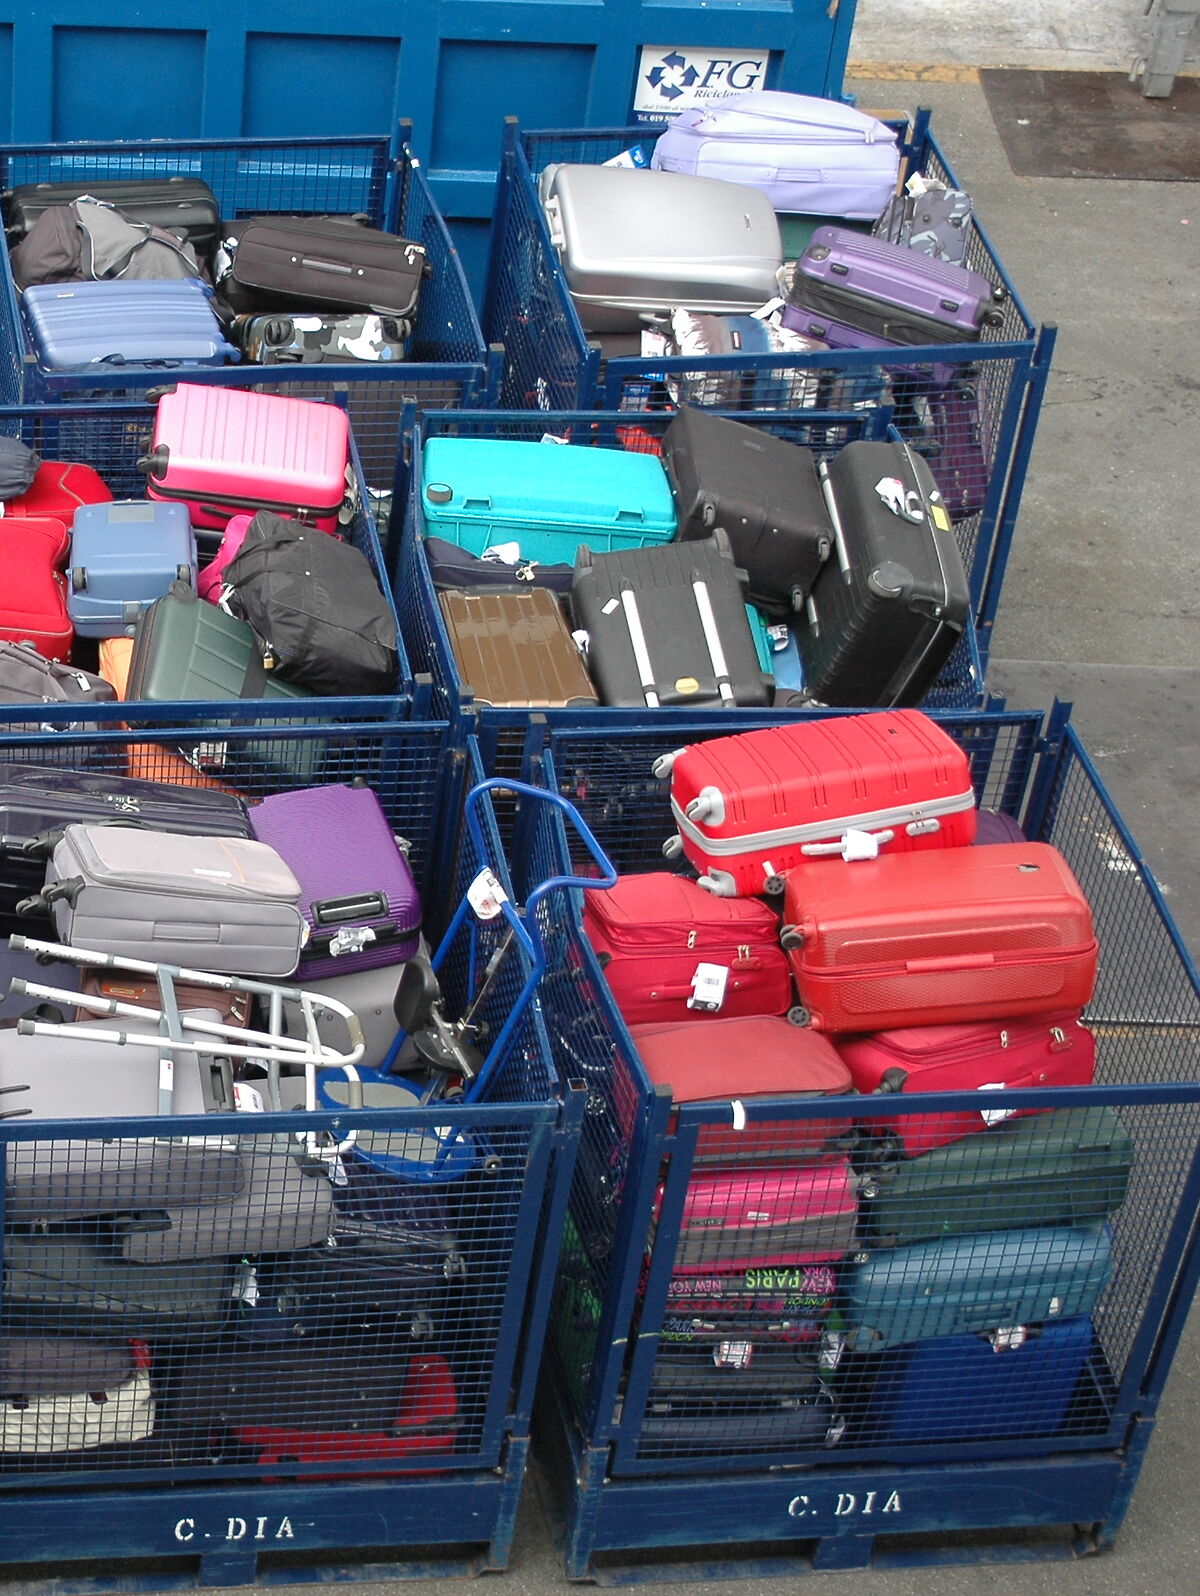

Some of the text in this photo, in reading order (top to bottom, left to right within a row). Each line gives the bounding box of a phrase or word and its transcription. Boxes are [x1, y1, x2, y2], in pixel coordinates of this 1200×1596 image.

[694, 90, 742, 98] Ricicla
[696, 1280, 722, 1292] NEW
[746, 1269, 799, 1289] PARIS
[834, 1490, 901, 1515] DIA
[225, 1516, 294, 1540] DIA
